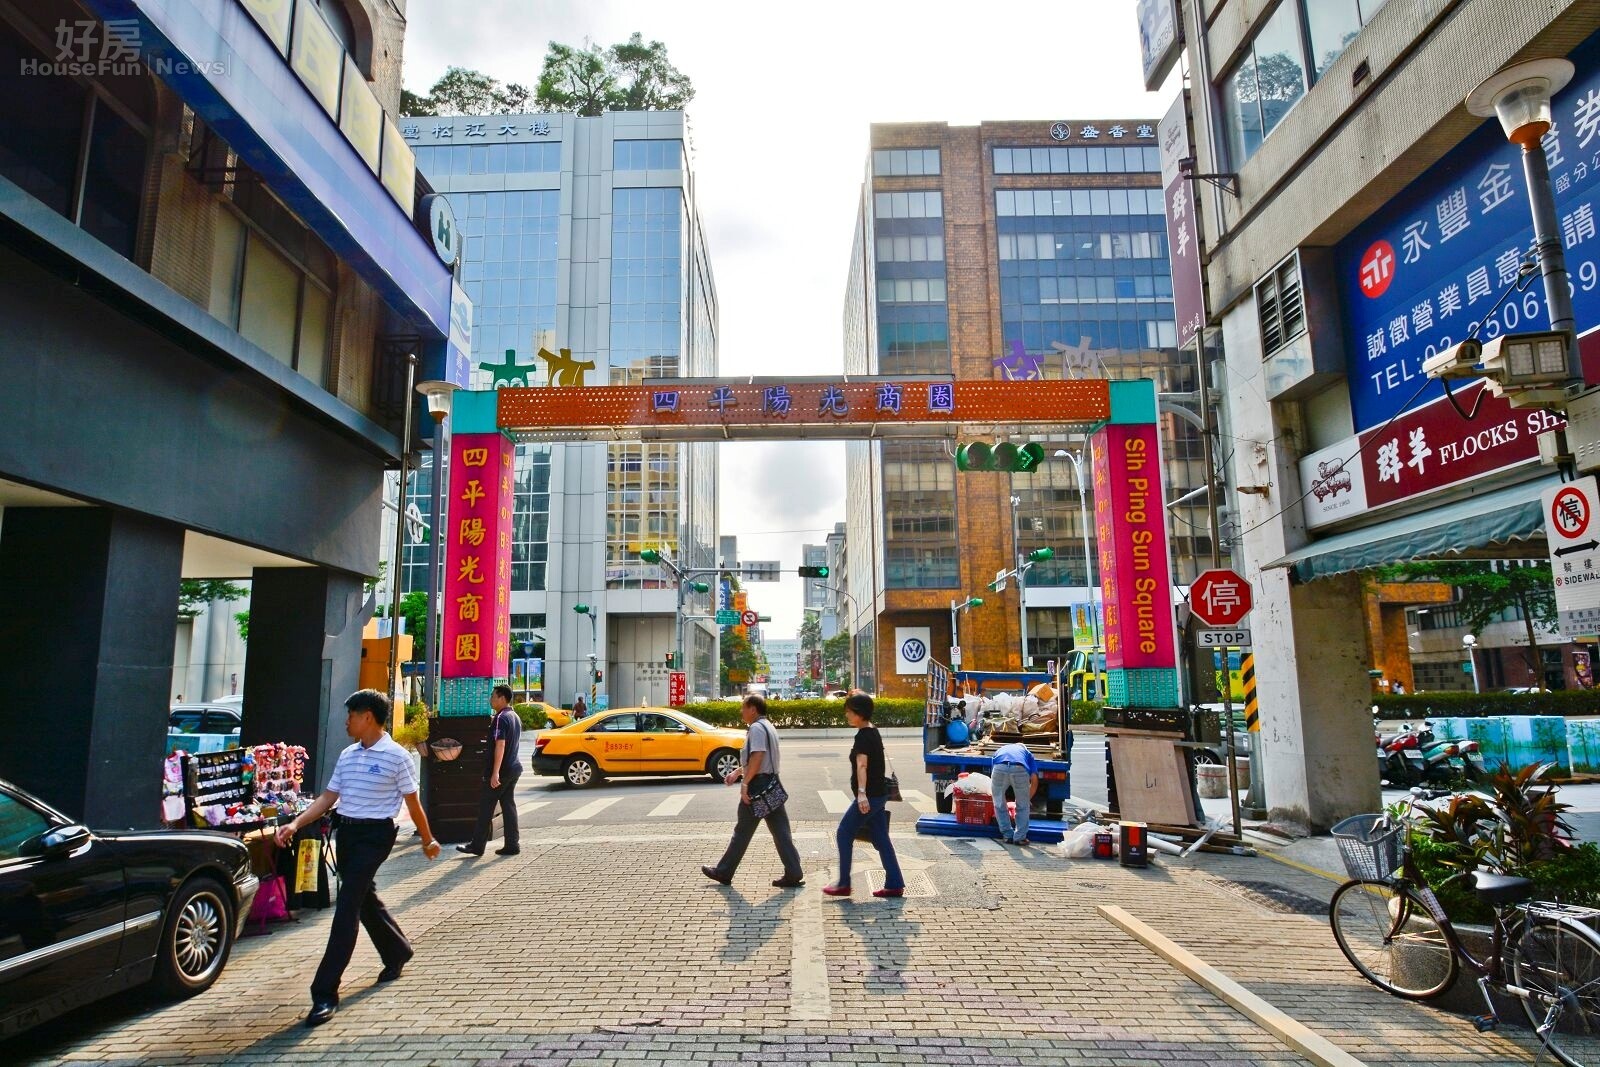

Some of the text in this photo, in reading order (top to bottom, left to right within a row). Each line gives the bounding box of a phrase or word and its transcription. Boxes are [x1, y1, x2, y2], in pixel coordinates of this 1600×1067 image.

[402, 120, 551, 139] 堂松江大樓
[1079, 124, 1155, 139] 盛香堂
[1171, 182, 1190, 257] 群羊
[652, 383, 955, 416] 四平陽光商圈
[1376, 426, 1432, 484] 群羊
[1439, 419, 1519, 467] FLOCKS
[1559, 498, 1581, 529] 停
[455, 447, 489, 662] 四平陽光商圈
[1124, 438, 1157, 654] Sih Ping Sun Square
[1563, 558, 1593, 573] 騎樓
[1201, 579, 1241, 616] 停
[1204, 632, 1245, 644] STOP
